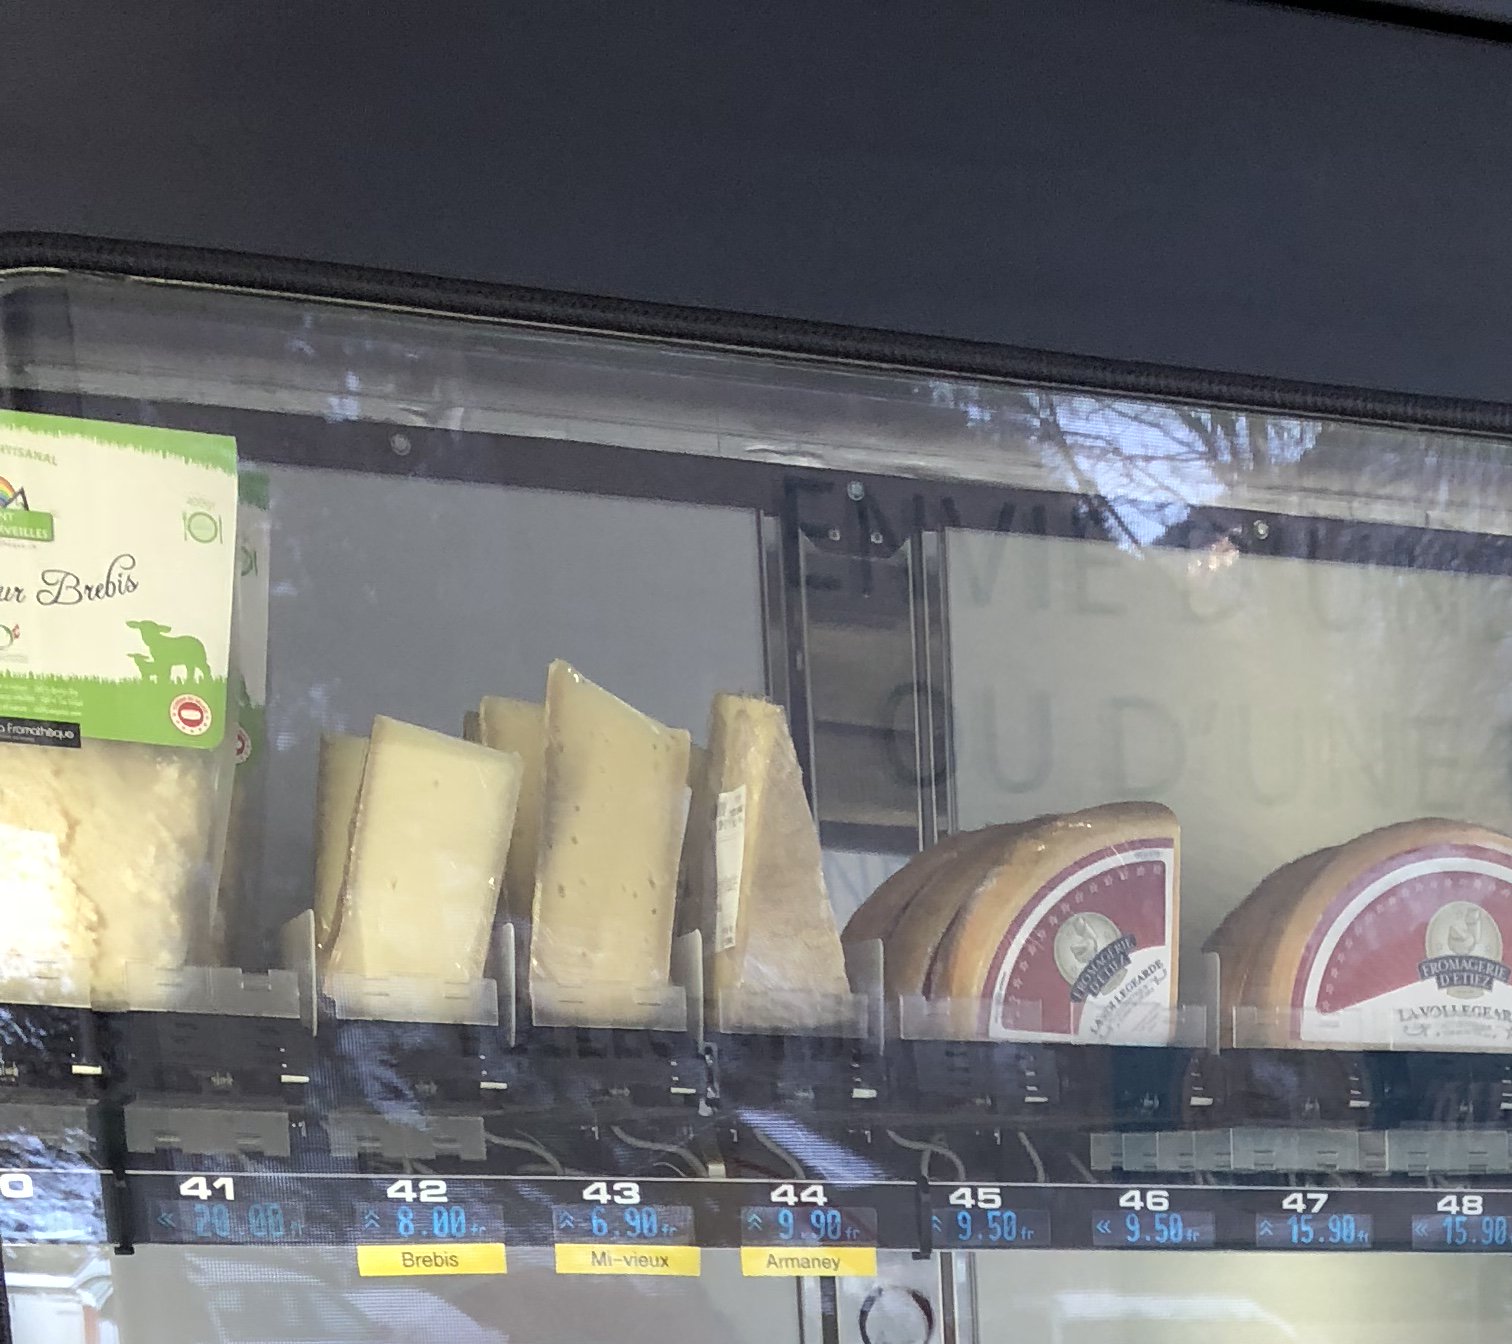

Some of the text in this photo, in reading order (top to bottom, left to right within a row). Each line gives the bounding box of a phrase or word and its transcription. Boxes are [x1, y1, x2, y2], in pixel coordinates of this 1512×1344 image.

[36, 553, 139, 606] Brebis
[1421, 957, 1508, 980] FROMAGERIE
[180, 1175, 236, 1201] 41
[386, 1180, 449, 1203] 42
[582, 1182, 642, 1205] 43
[770, 1184, 828, 1206] 44
[948, 1187, 1003, 1210] 45
[1118, 1190, 1171, 1213] 46
[1281, 1192, 1329, 1215] 47
[1436, 1195, 1484, 1216] 48
[396, 1206, 467, 1238] 8.00
[590, 1206, 658, 1238] 6.90
[778, 1208, 842, 1240] 9.90
[957, 1210, 1018, 1242] 9.50
[1125, 1213, 1185, 1244] 9.50
[1288, 1214, 1356, 1246] 15.90
[1443, 1215, 1507, 1246] 15.90
[402, 1250, 460, 1270] Brebis
[590, 1250, 670, 1270] Mi-vieux
[765, 1253, 842, 1273] Armaney
